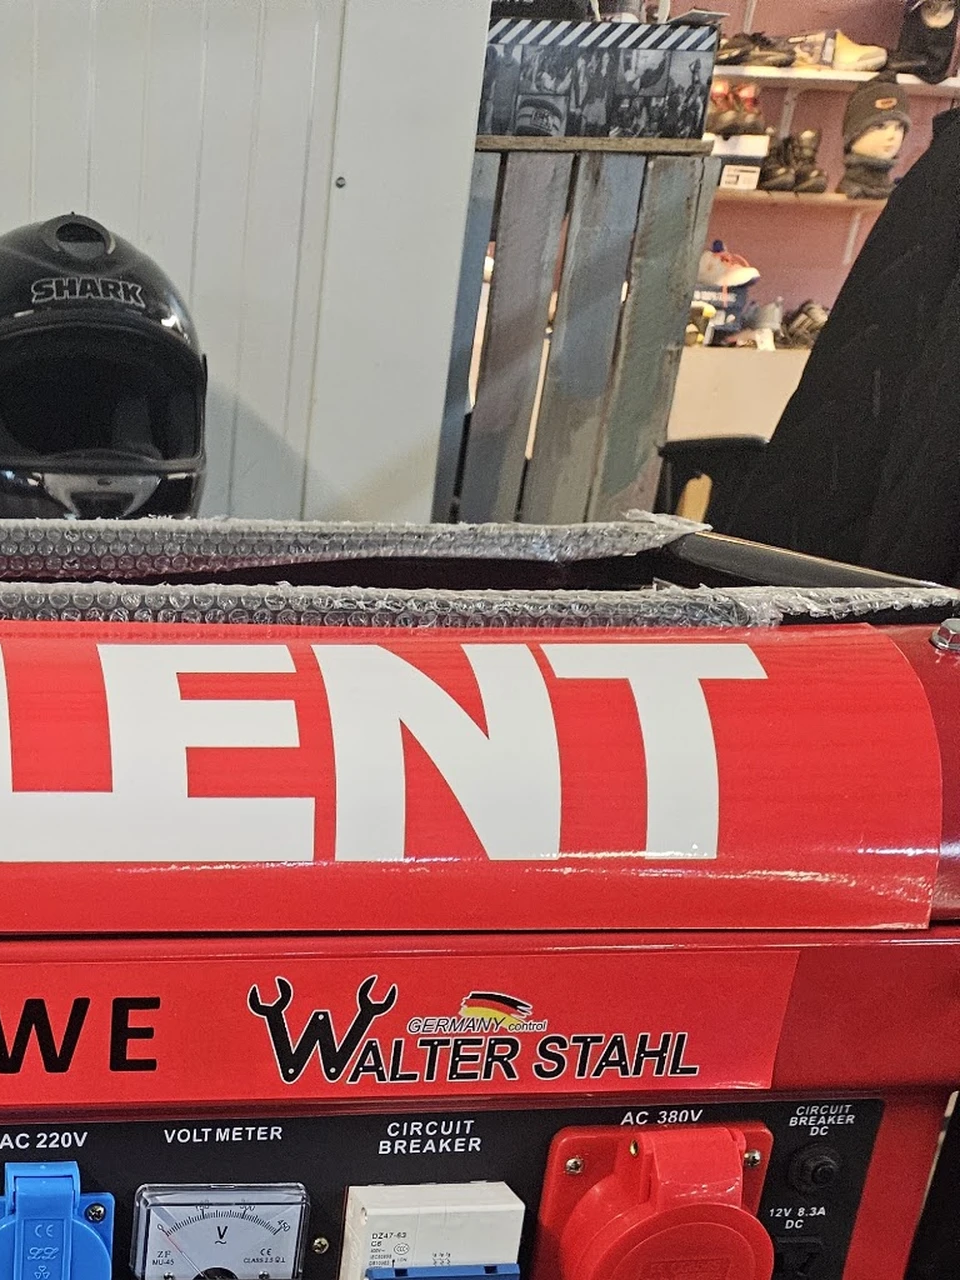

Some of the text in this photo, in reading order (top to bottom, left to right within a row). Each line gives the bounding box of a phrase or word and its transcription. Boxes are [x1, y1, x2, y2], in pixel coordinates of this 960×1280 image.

[31, 276, 145, 308] SHARK
[247, 975, 699, 1084] WALTER STAHL
[407, 1016, 548, 1034] GERMANY control
[620, 1109, 703, 1126] AC 380V
[796, 1104, 852, 1116] CIRCUIT
[386, 1119, 475, 1138] CIRCUIT
[789, 1115, 855, 1127] BREAKER
[809, 1126, 829, 1136] DC
[36, 1131, 88, 1149] 220V
[378, 1137, 482, 1156] BREAKER
[769, 1206, 826, 1217] 12V 8.3A
[785, 1219, 804, 1230] DC
